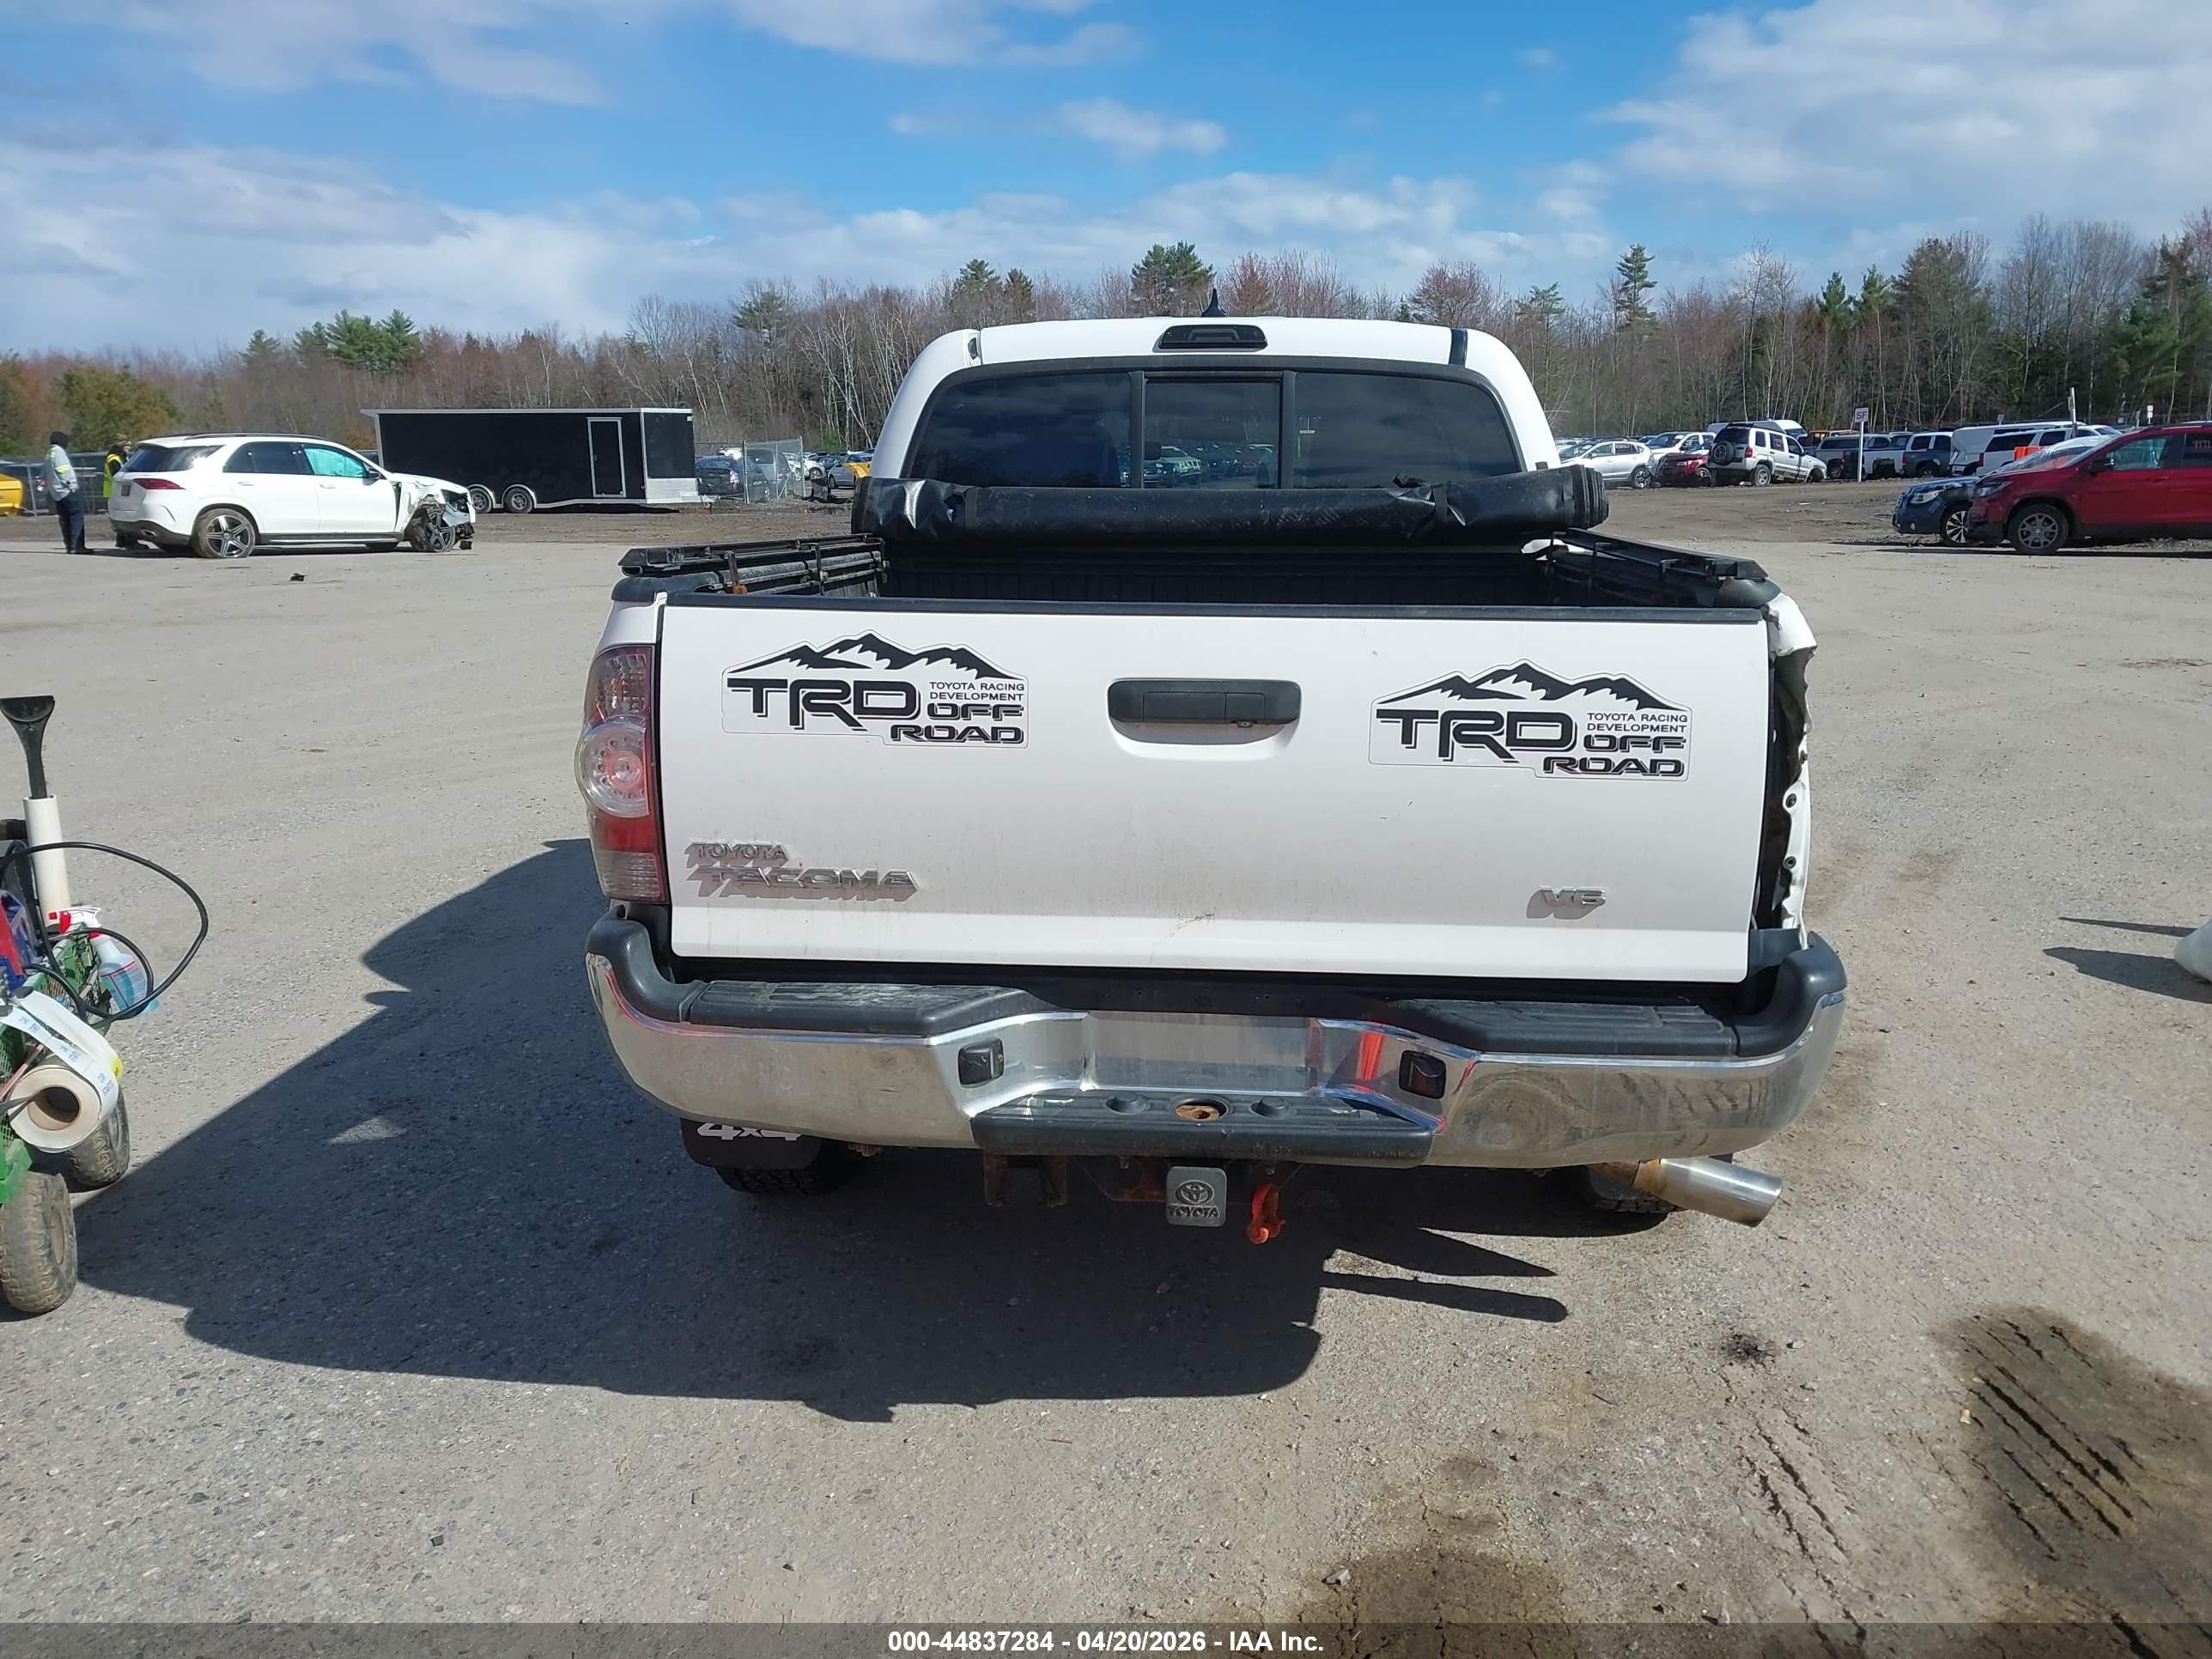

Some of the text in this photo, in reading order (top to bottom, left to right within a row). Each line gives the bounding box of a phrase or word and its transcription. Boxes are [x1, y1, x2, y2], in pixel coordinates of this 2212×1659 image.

[1856, 410, 1868, 420] SF
[929, 681, 1024, 691] TOYOTA RACING
[726, 678, 921, 732] TRD
[929, 692, 1024, 702] DEVELOPMENT
[927, 702, 1024, 721] OFF
[1587, 712, 1688, 723] TOYOTA RACING
[890, 724, 1025, 744] ROAD
[1376, 708, 1578, 763] TRD
[1586, 723, 1687, 733] DEVELOPMENT
[1583, 734, 1686, 754] OFF
[1542, 756, 1686, 777] ROAD
[691, 842, 788, 860] TOYOTA
[694, 866, 919, 895] TACOMA
[1168, 1205, 1220, 1218] TOYOTA
